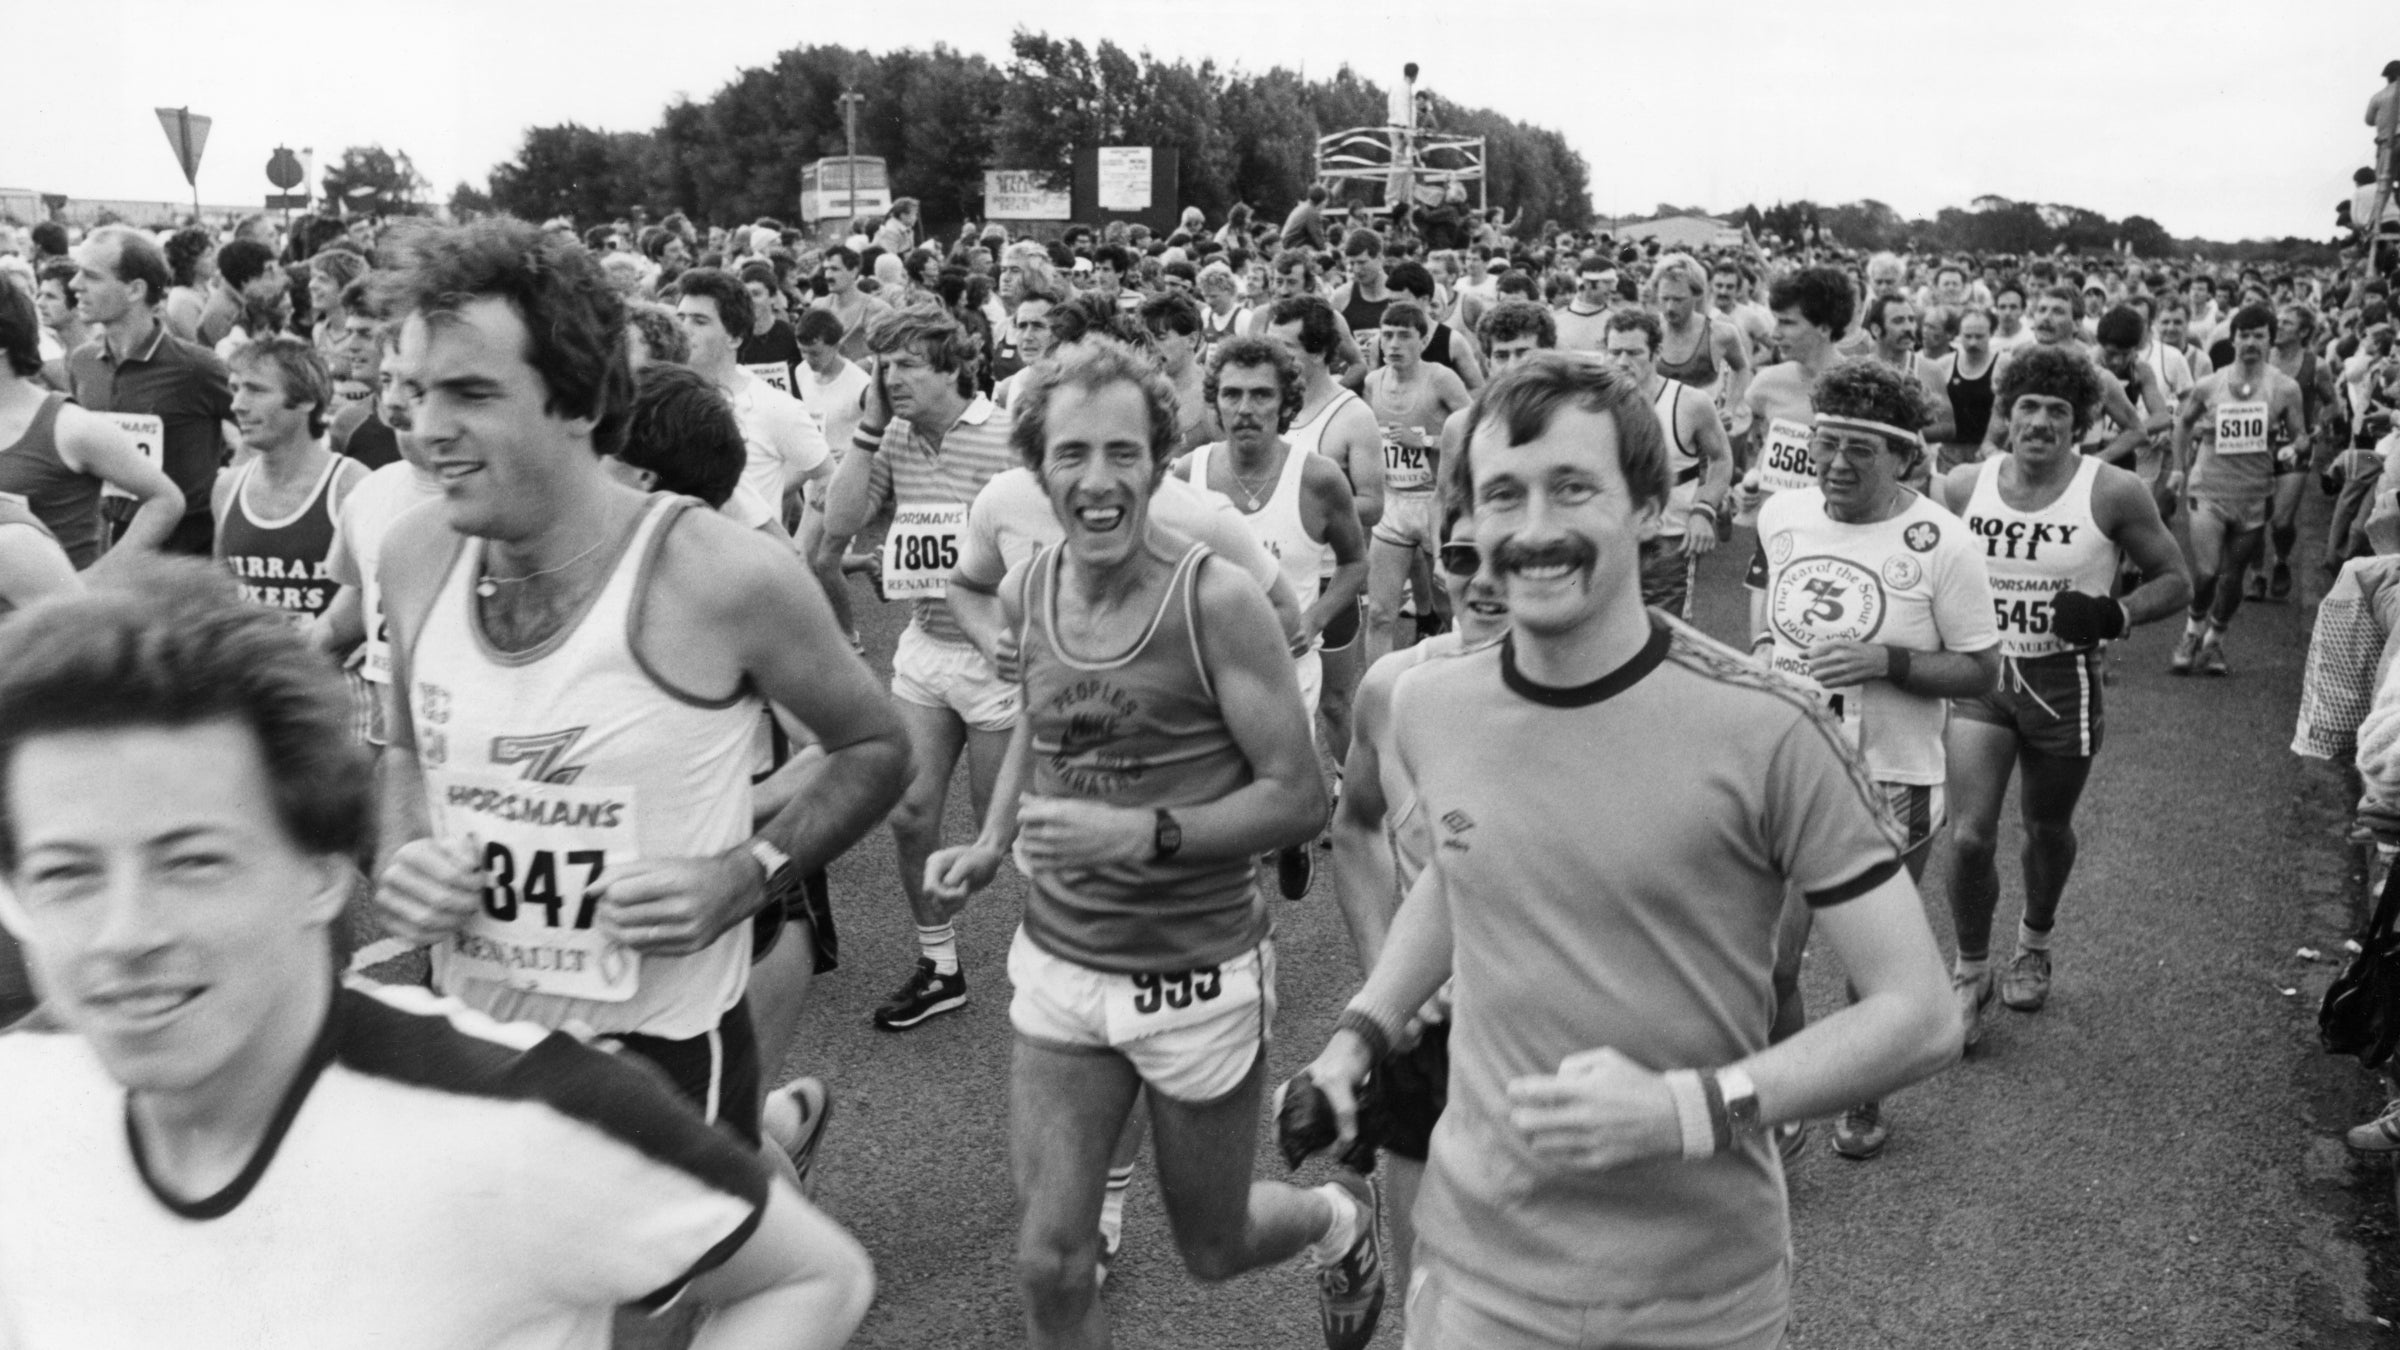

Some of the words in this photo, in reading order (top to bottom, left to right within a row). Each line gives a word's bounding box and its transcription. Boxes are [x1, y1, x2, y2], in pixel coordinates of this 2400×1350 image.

[2221, 419, 2263, 438] 5310
[1384, 446, 1424, 469] 1742
[1969, 516, 2078, 545] ROCKY
[894, 534, 958, 570] 1805
[1993, 598, 2056, 634] 545
[1775, 656, 1811, 677] HORS
[483, 841, 606, 930] 347
